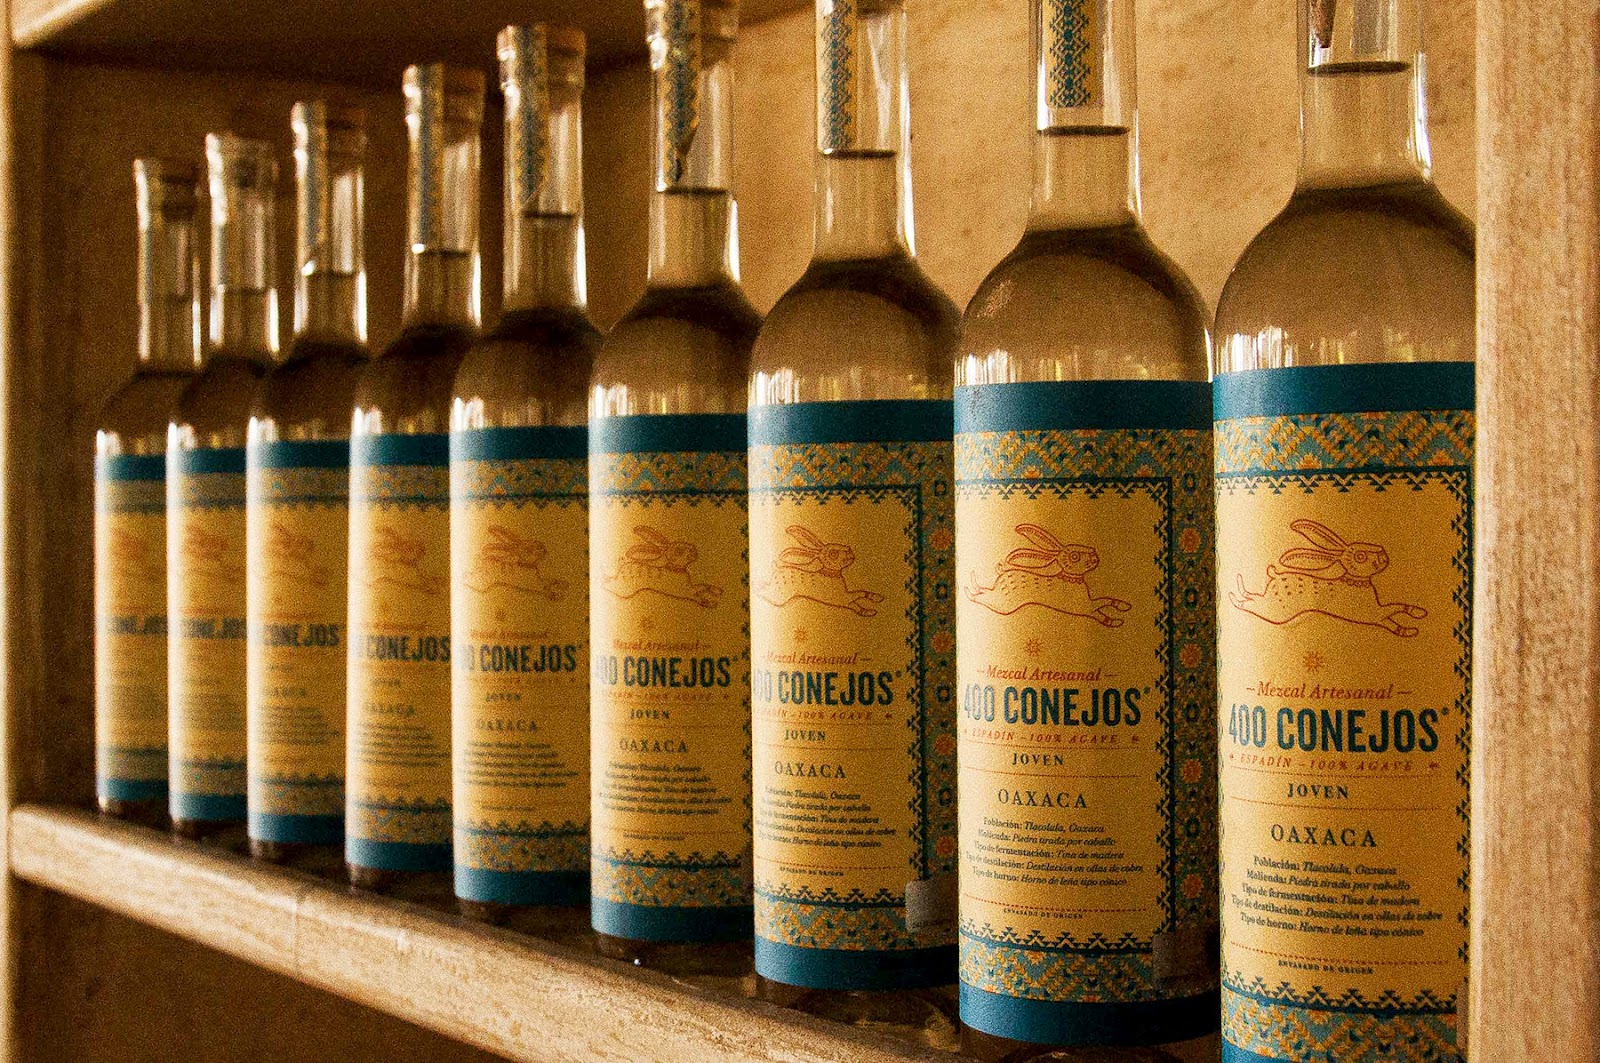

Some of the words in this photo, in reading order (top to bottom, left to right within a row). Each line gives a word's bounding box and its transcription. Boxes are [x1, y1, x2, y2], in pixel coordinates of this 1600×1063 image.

[480, 643, 577, 673] CONEJOS
[798, 652, 858, 665] Artesanal
[624, 656, 730, 688] CONEJOS
[987, 665, 1027, 680] Mezcal
[1029, 667, 1101, 681] Artesanal
[778, 671, 893, 706] CONEJOS
[1257, 681, 1305, 698] Mezcal
[1309, 683, 1393, 700] Artesanal
[964, 683, 995, 722] 400
[1004, 686, 1141, 726] CONEJOS
[785, 729, 826, 742] JOVEN
[1228, 703, 1266, 748] 400
[1277, 707, 1438, 753] CONEJOS
[1069, 734, 1118, 744] AGAVE
[1012, 753, 1064, 766] JOVEN
[1241, 752, 1291, 768] ESPADÍN
[1357, 760, 1411, 771] AGAVE
[775, 761, 846, 779] OAXACA
[998, 789, 1087, 809] OAXACA
[1287, 783, 1348, 799] JOVEN
[1024, 821, 1066, 834] Tlacolula,
[1271, 824, 1377, 847] OAXACA
[1078, 850, 1089, 859] de
[1246, 869, 1287, 884] Molienda:
